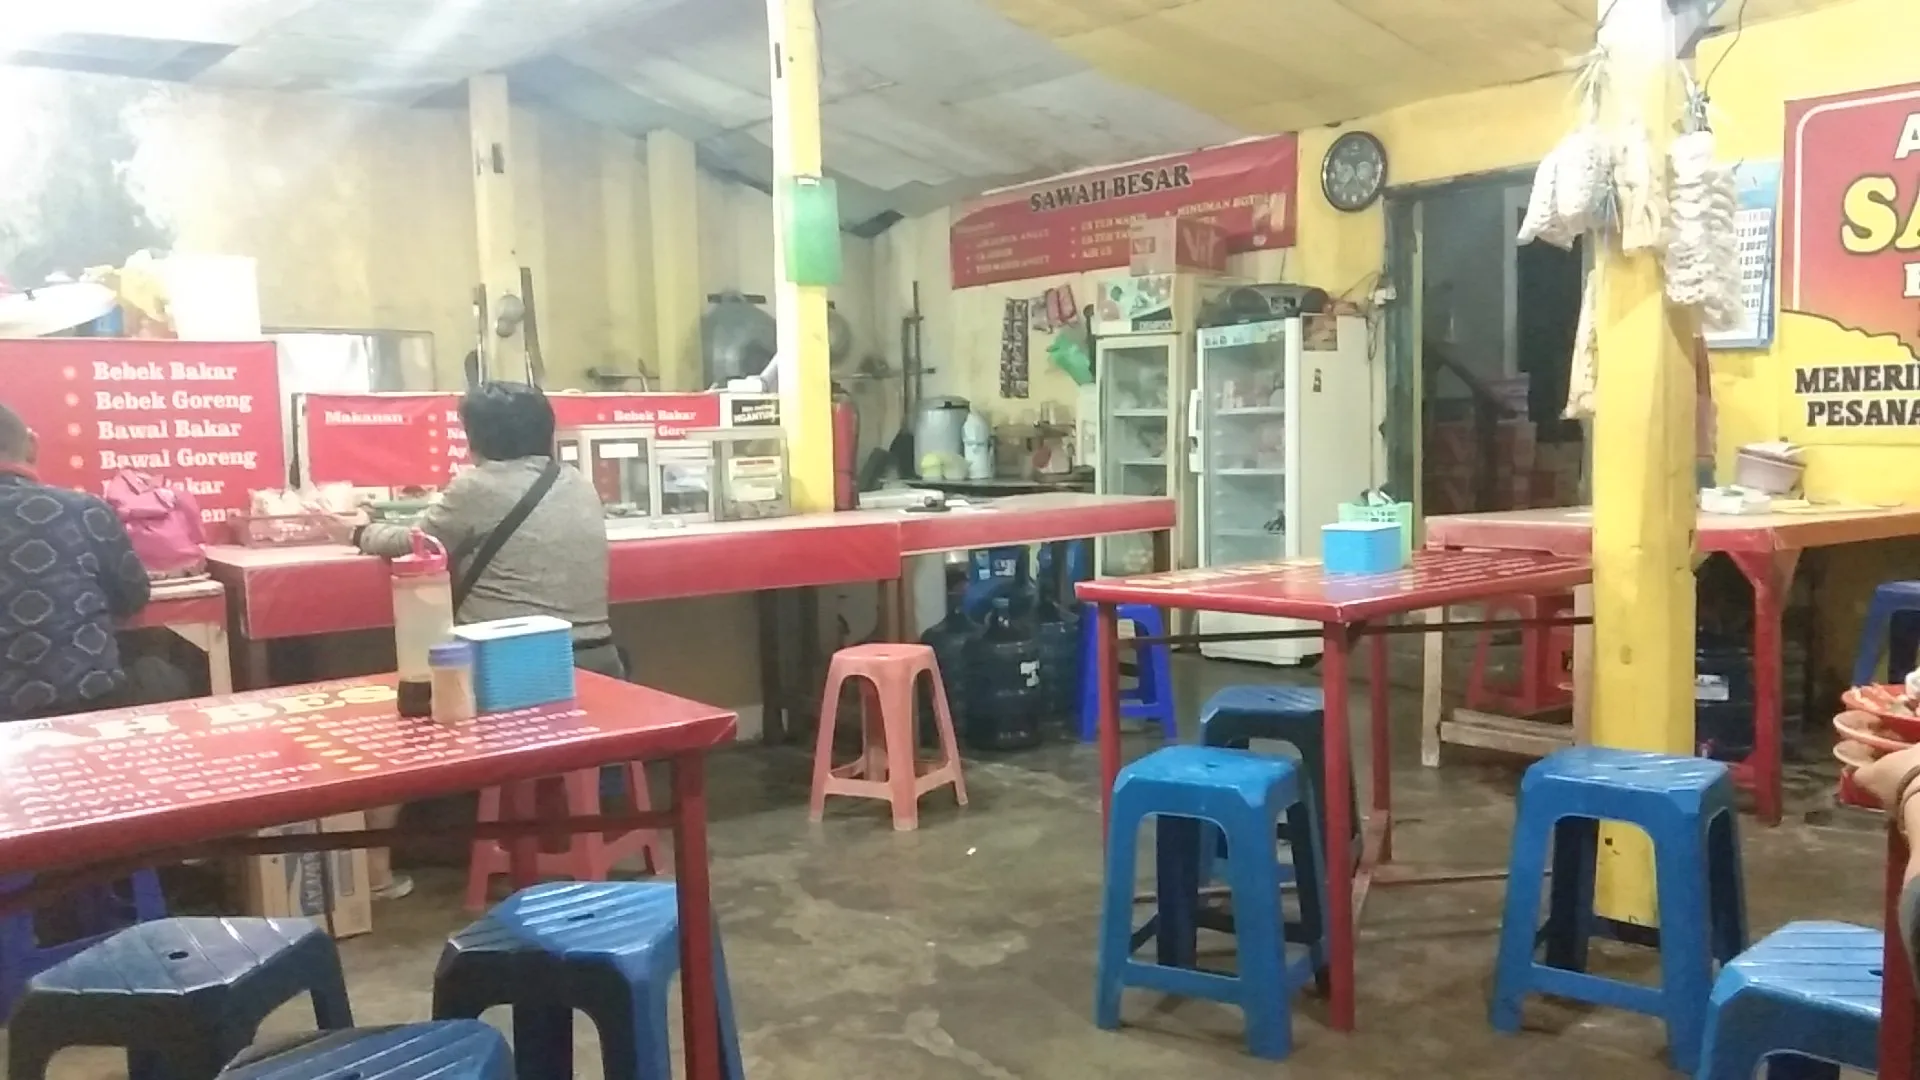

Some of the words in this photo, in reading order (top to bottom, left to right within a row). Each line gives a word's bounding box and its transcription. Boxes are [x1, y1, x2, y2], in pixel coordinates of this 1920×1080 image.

[1030, 181, 1108, 213] SAWAH
[1112, 163, 1193, 199] BESAR
[92, 361, 164, 381] Bebek
[169, 362, 237, 381] Bakar
[1795, 363, 1920, 394] MENERI
[95, 391, 167, 411] Bebek
[172, 391, 253, 413] Goreng
[324, 410, 404, 426] Makanan
[613, 409, 655, 422] Bebek
[657, 409, 697, 421] Bakar
[98, 420, 169, 440] Bawal
[174, 419, 242, 438] Bakar
[446, 428, 468, 440] Na
[657, 425, 687, 437] Gor
[100, 449, 170, 470] Bawal
[176, 448, 257, 470] Goreng
[197, 685, 398, 726] BES
[316, 713, 397, 729] Bebe
[468, 709, 589, 733] Goreng
[139, 750, 280, 776] Goreng
[148, 763, 257, 785] Bakar
[174, 762, 322, 791] Goreng
[185, 775, 303, 800] Bakar
